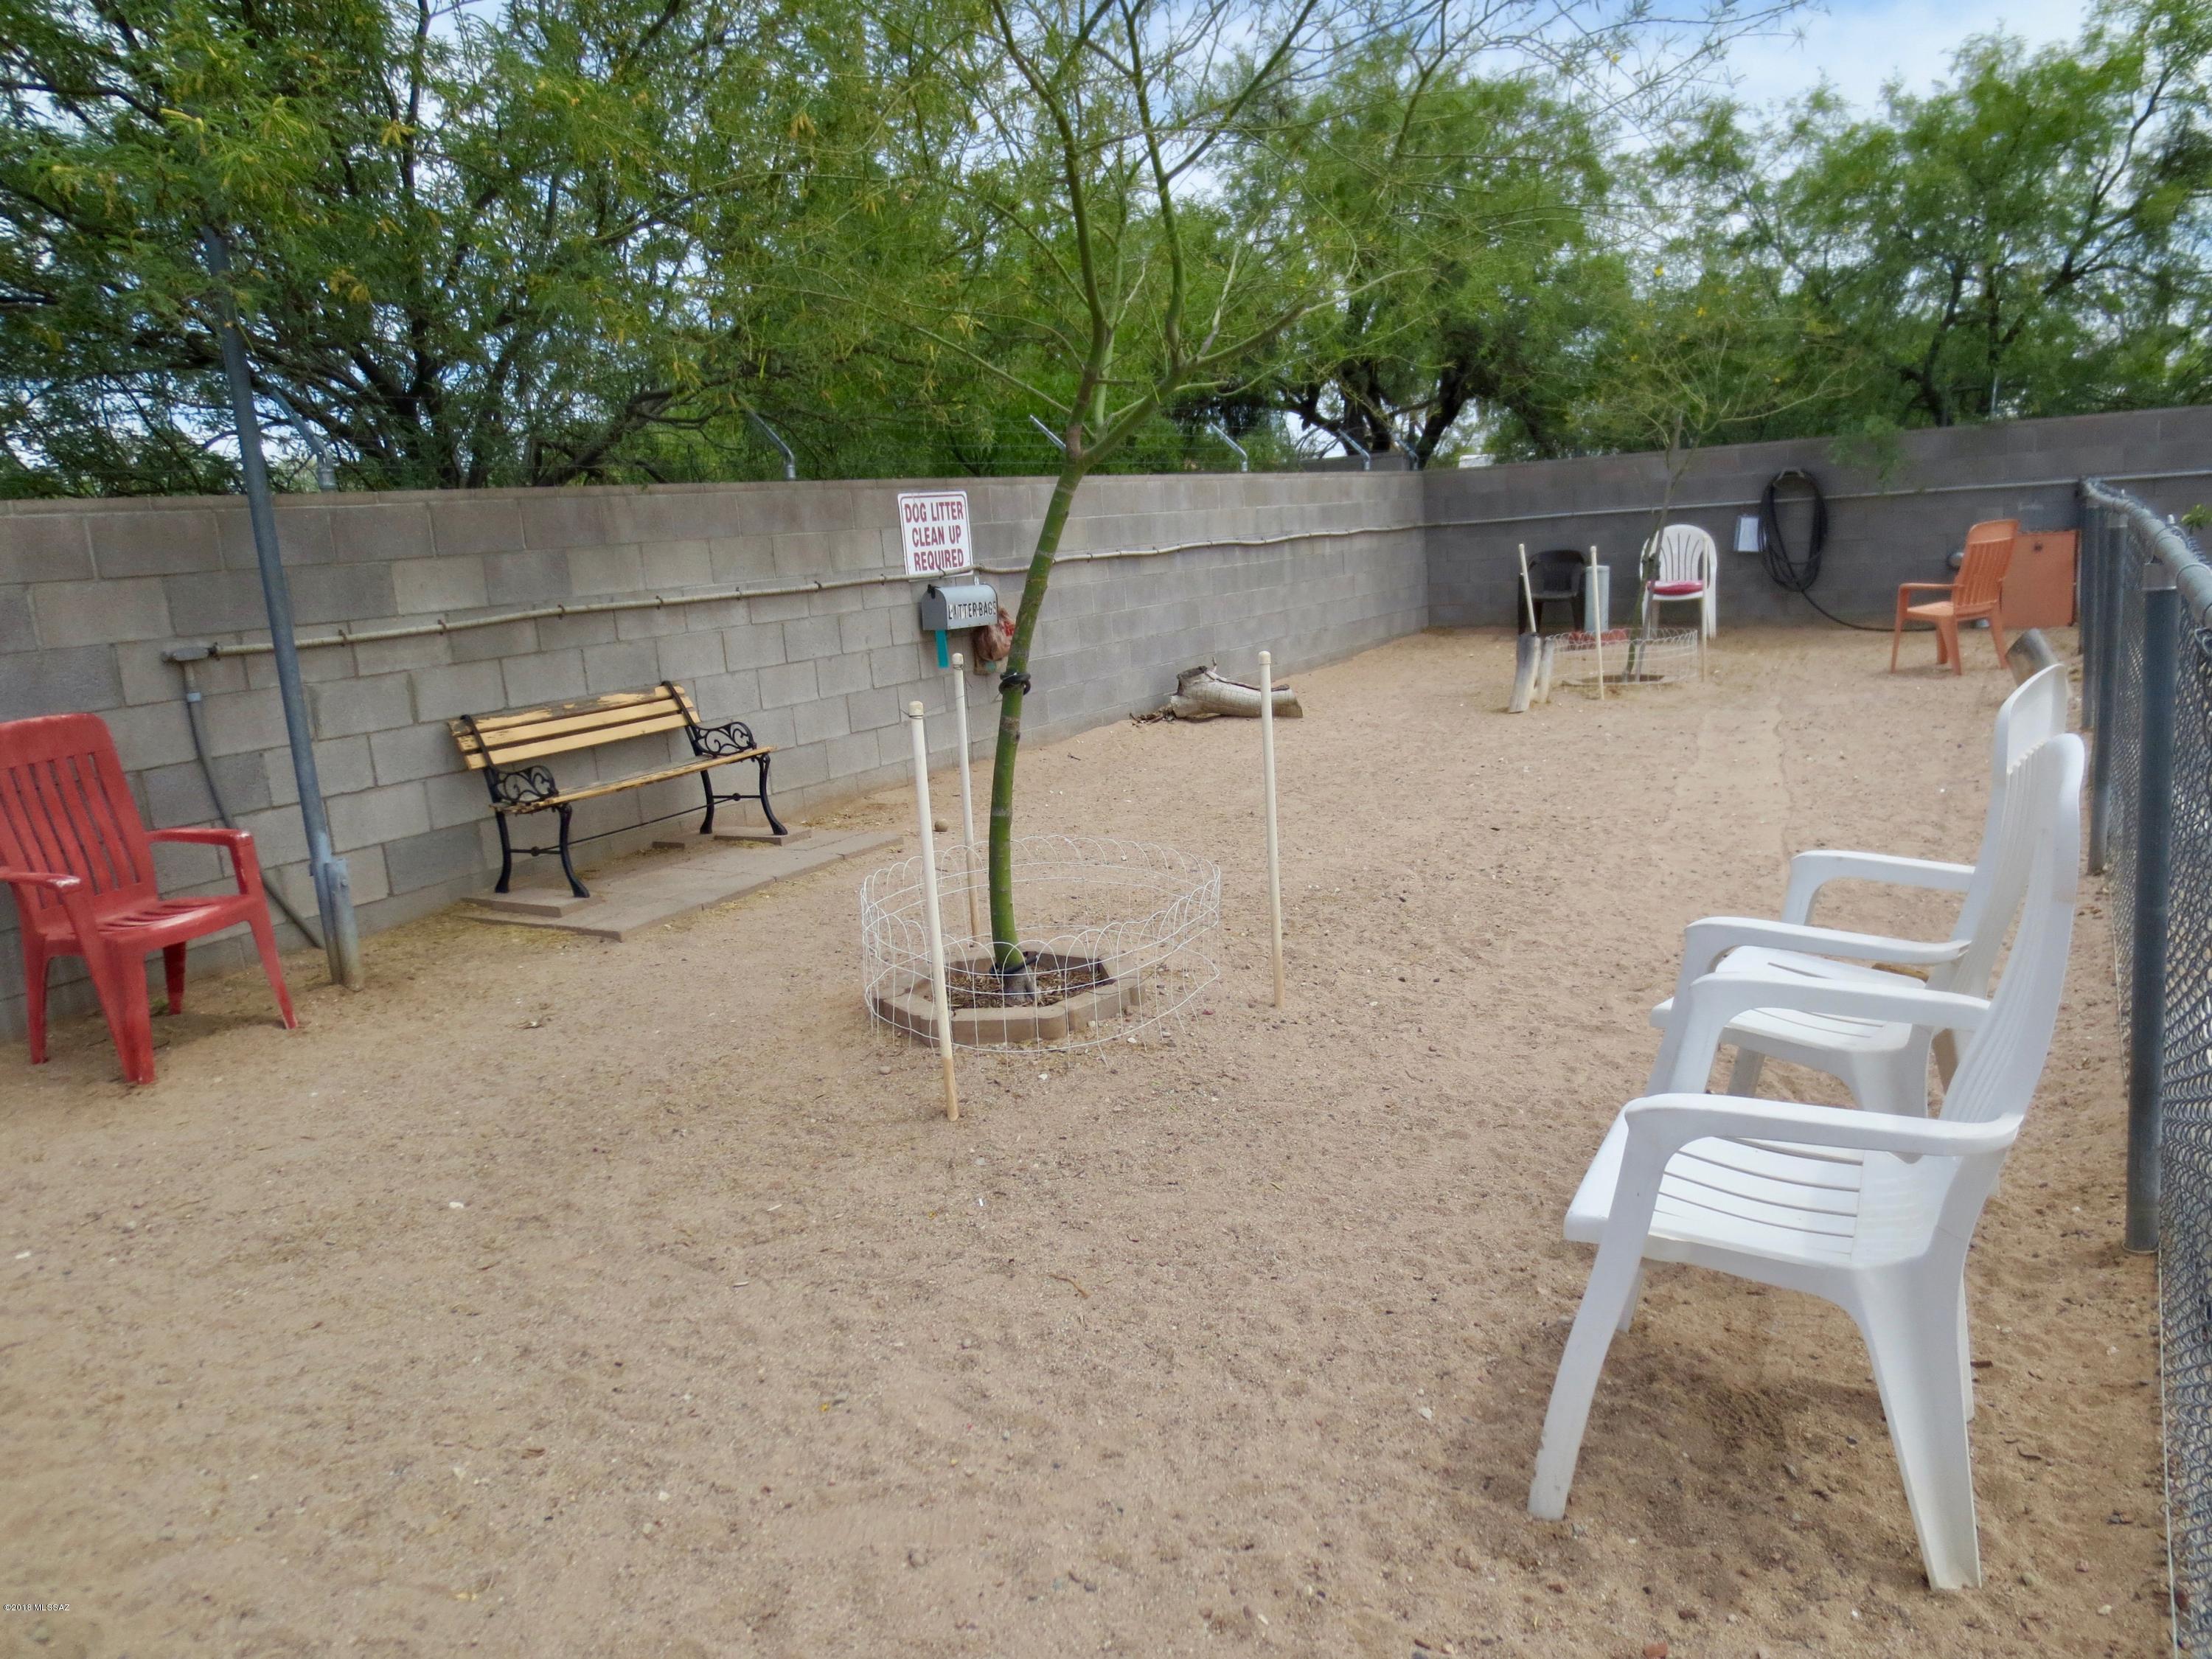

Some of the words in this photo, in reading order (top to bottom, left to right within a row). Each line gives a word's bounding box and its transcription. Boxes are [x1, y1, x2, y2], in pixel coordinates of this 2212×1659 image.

[904, 502, 927, 523] DOG
[931, 501, 964, 521] LITTER
[911, 526, 945, 548] CLEAN
[948, 524, 961, 544] UP
[914, 548, 964, 571] REQUIRED
